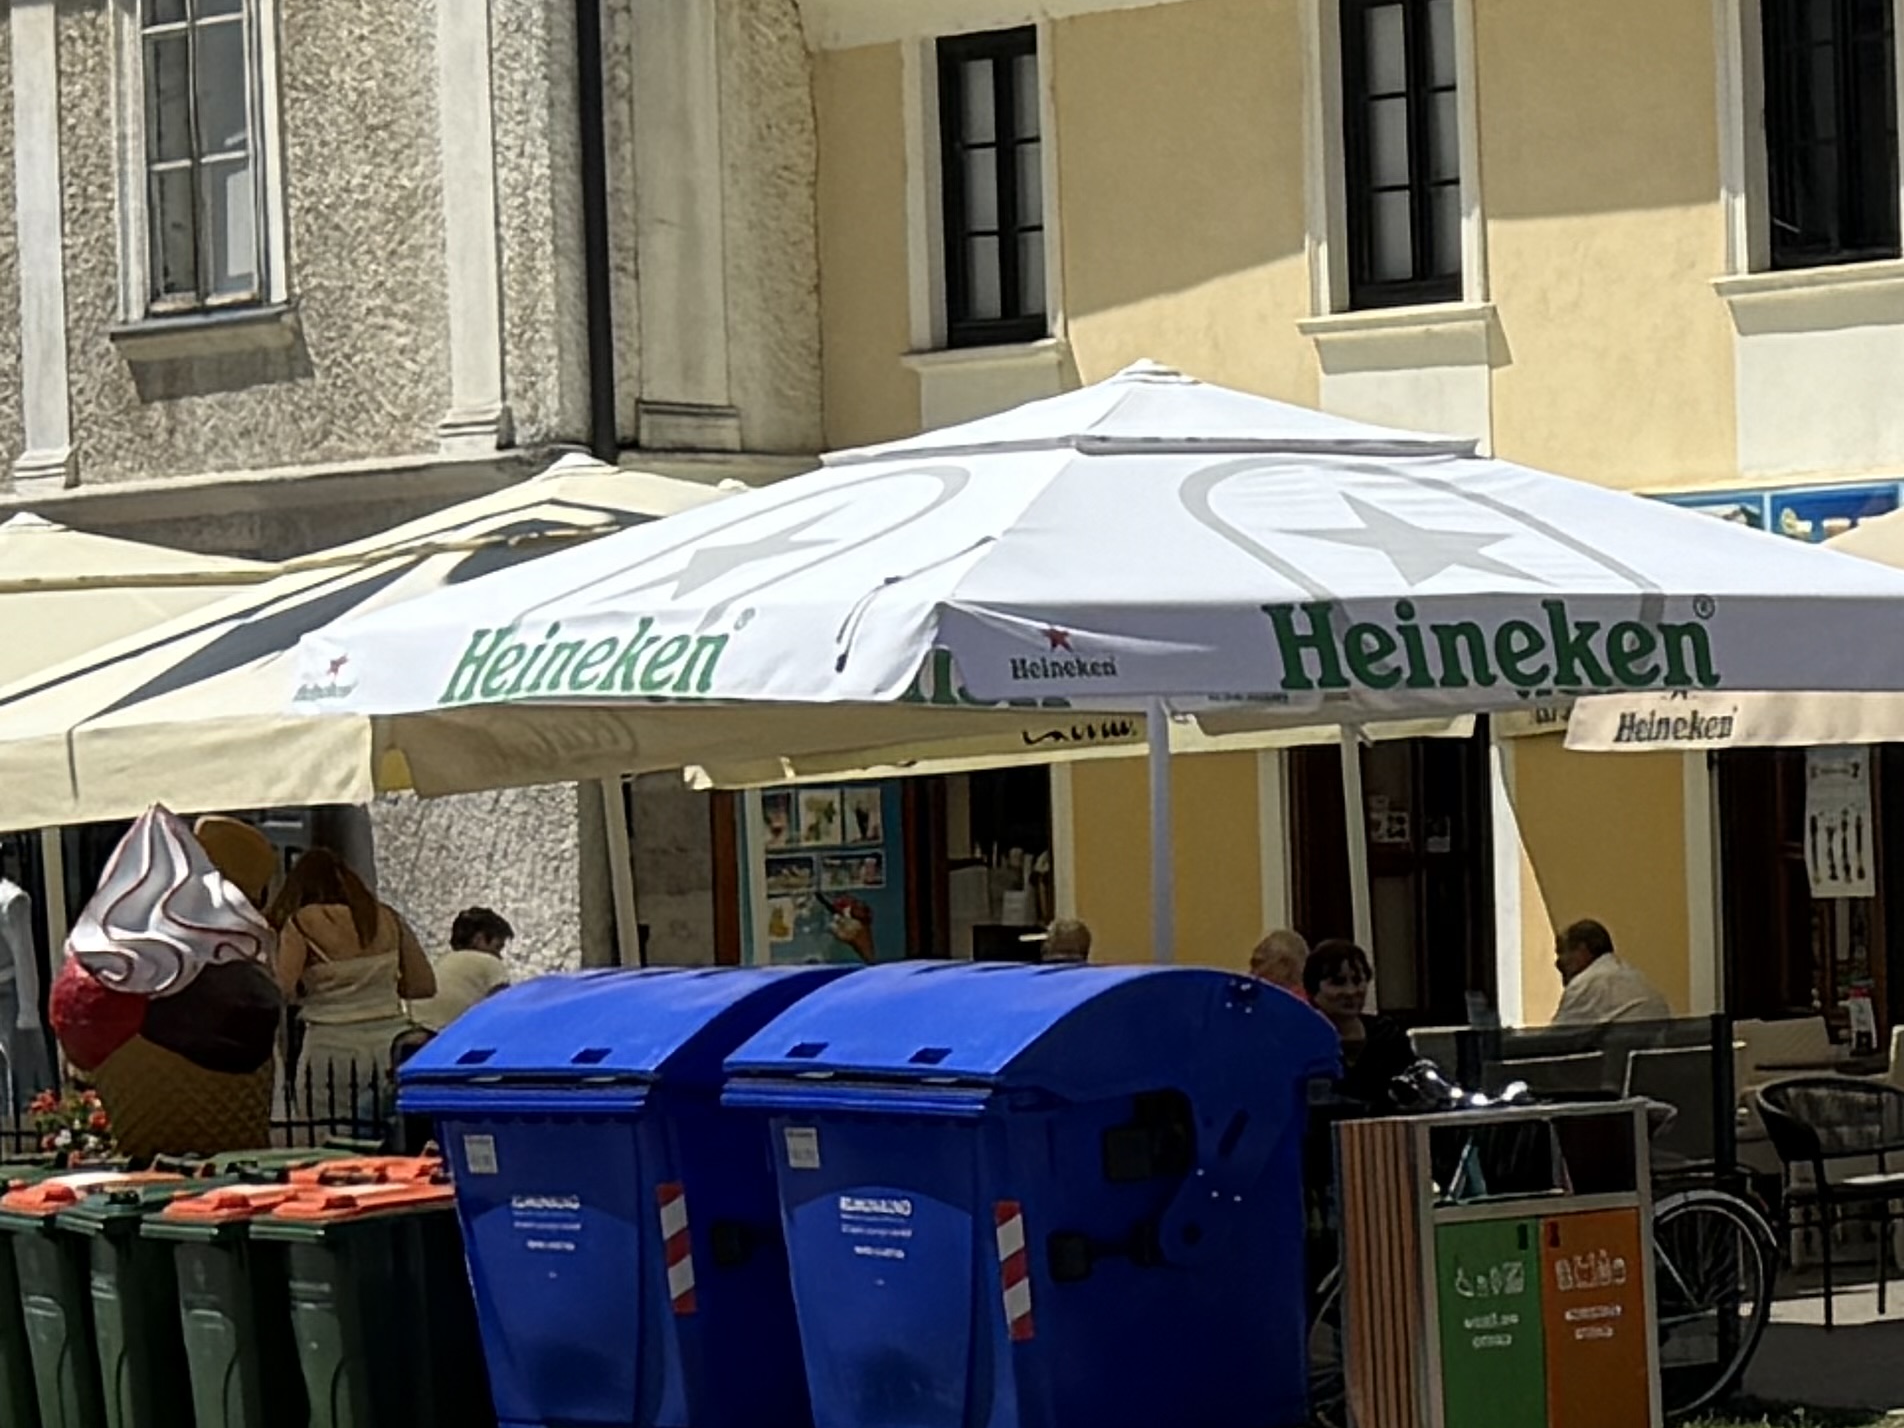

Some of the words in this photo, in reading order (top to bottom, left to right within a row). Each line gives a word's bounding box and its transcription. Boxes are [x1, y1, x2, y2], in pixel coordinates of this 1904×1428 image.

[437, 616, 730, 704] Heineken
[1010, 656, 1117, 680] Heineken
[1261, 598, 1720, 690] Heineken
[1613, 708, 1736, 743] Heineken
